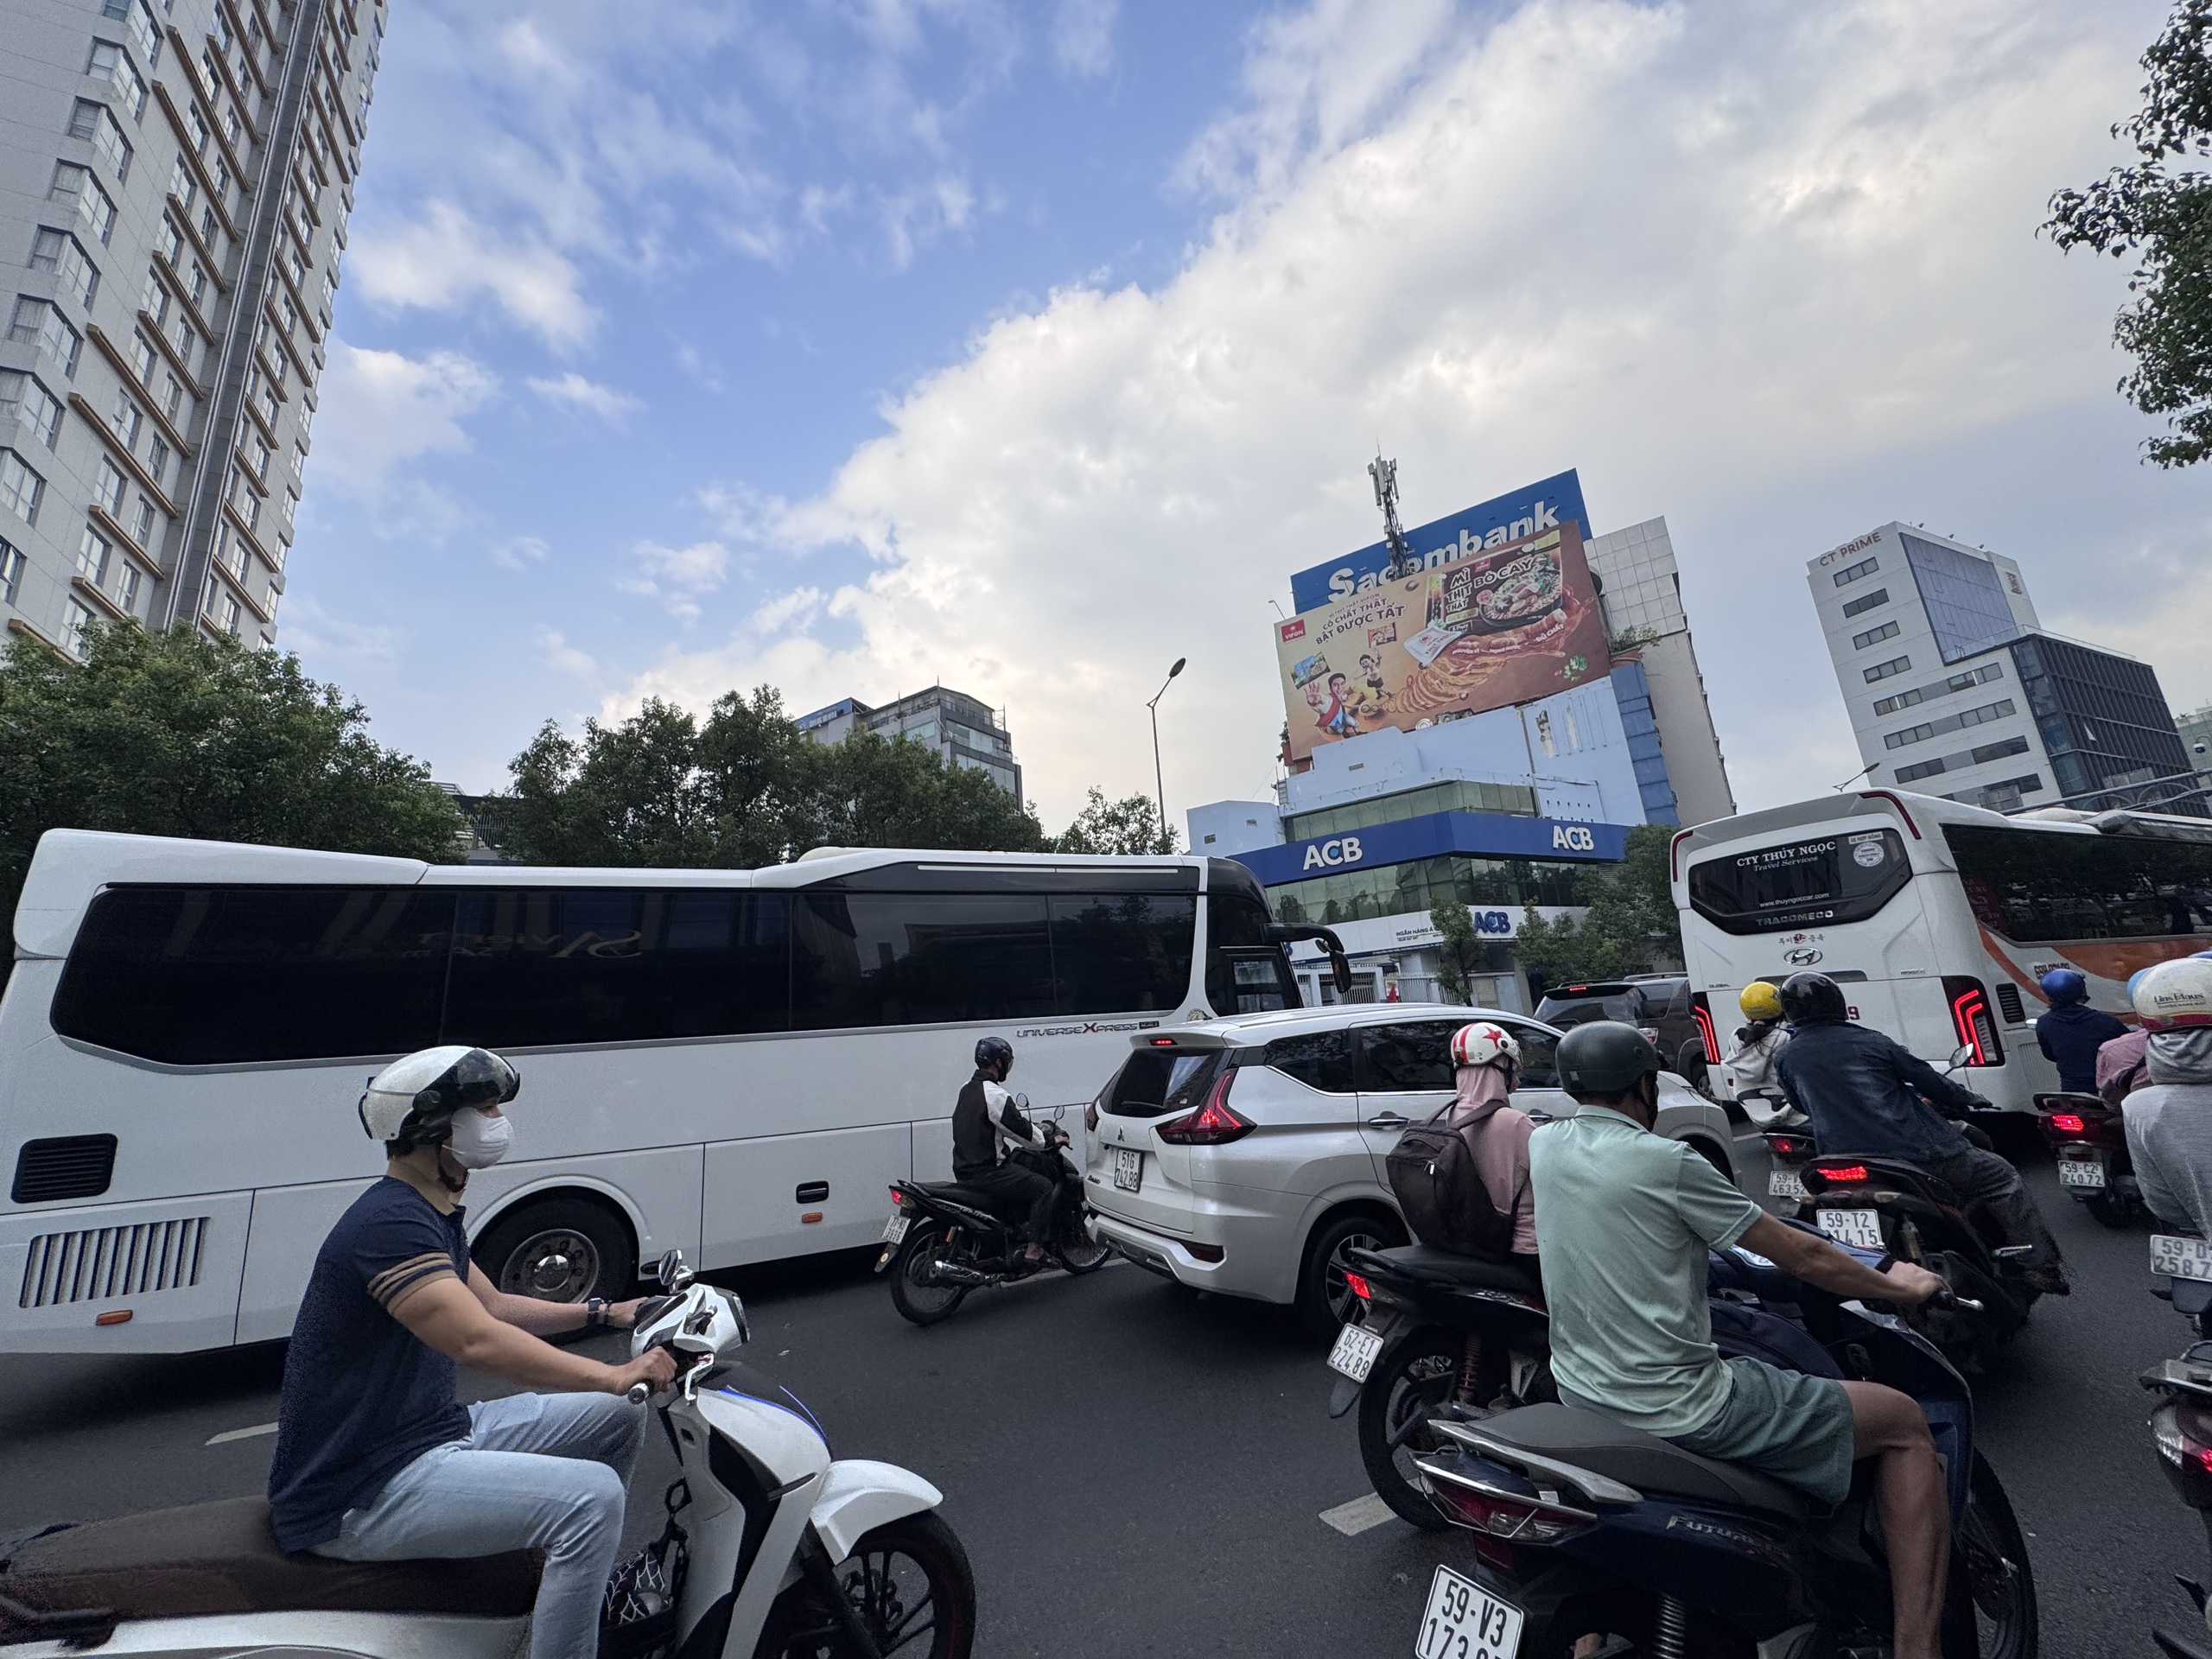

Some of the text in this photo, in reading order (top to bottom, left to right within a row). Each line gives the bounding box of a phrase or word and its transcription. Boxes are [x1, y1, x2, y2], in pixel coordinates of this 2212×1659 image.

[1820, 531, 1882, 567] CT PRIME
[1450, 567, 1471, 589] MÌ
[1474, 570, 1497, 588] BÒ
[1497, 556, 1535, 580] CAY
[1446, 583, 1472, 603] THỊT
[1315, 629, 1333, 645] BẬT
[1336, 613, 1374, 633] ĐƯỢC
[1377, 601, 1405, 620] TẤT
[1323, 597, 1389, 630] CÓ CHẤT THẬT
[1285, 629, 1304, 640] VIFON
[1553, 825, 1594, 851] ACB
[1302, 837, 1363, 871] ACB
[1737, 856, 1759, 867] CTY
[1762, 847, 1796, 863] THÚY
[1798, 841, 1836, 855] NGỌC
[1753, 855, 1818, 872] Travel Services
[1759, 892, 1829, 908] www.thuyngoccar.com
[1473, 912, 1510, 934] ACB
[1756, 910, 1834, 926] TRACOMECO
[1122, 1152, 1135, 1169] 51G
[1826, 1212, 1870, 1228] 59-T2
[1826, 1229, 1878, 1245] 14.15
[2162, 1239, 2212, 1259] 59-D
[1331, 1346, 1370, 1378] 224.88
